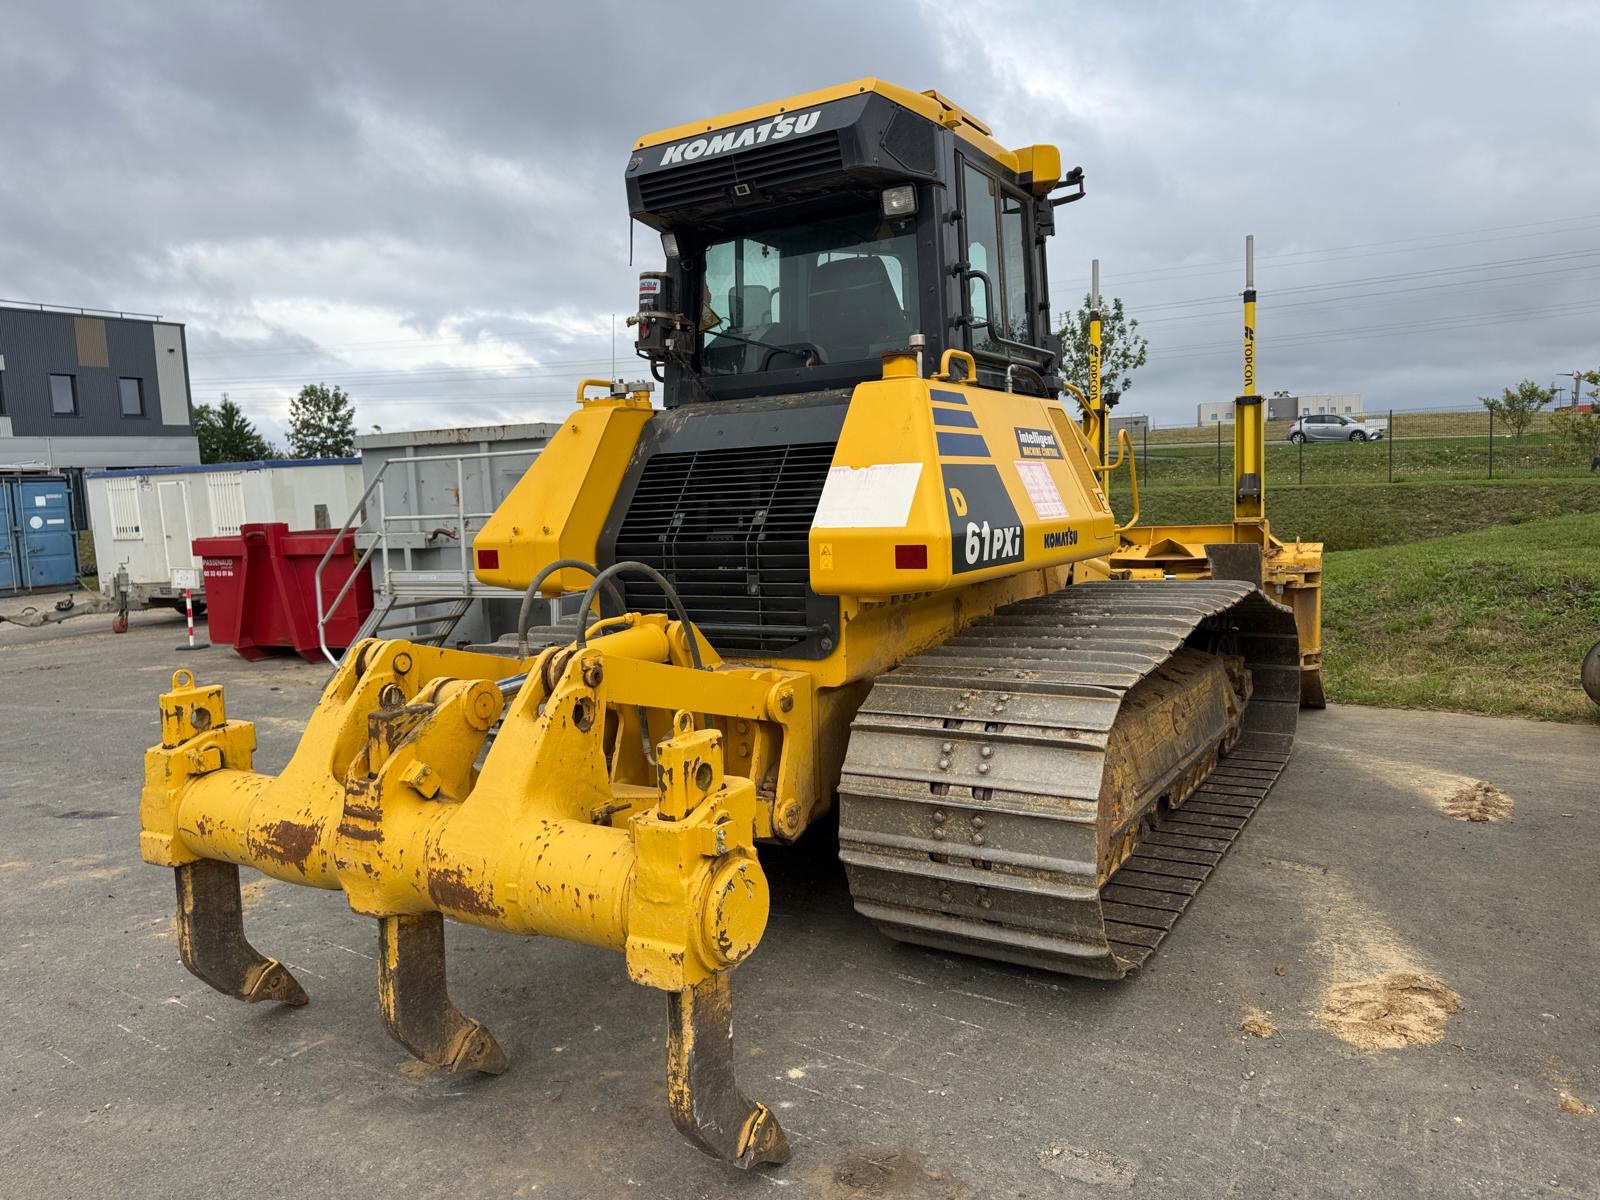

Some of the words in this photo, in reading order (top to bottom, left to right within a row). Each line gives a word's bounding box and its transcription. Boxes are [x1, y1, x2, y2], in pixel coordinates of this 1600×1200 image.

[660, 111, 821, 167] KOMATSU
[1018, 430, 1056, 447] intelligent
[948, 487, 968, 517] D
[965, 521, 1021, 565] 61PXi
[1044, 526, 1078, 549] KOMATSU
